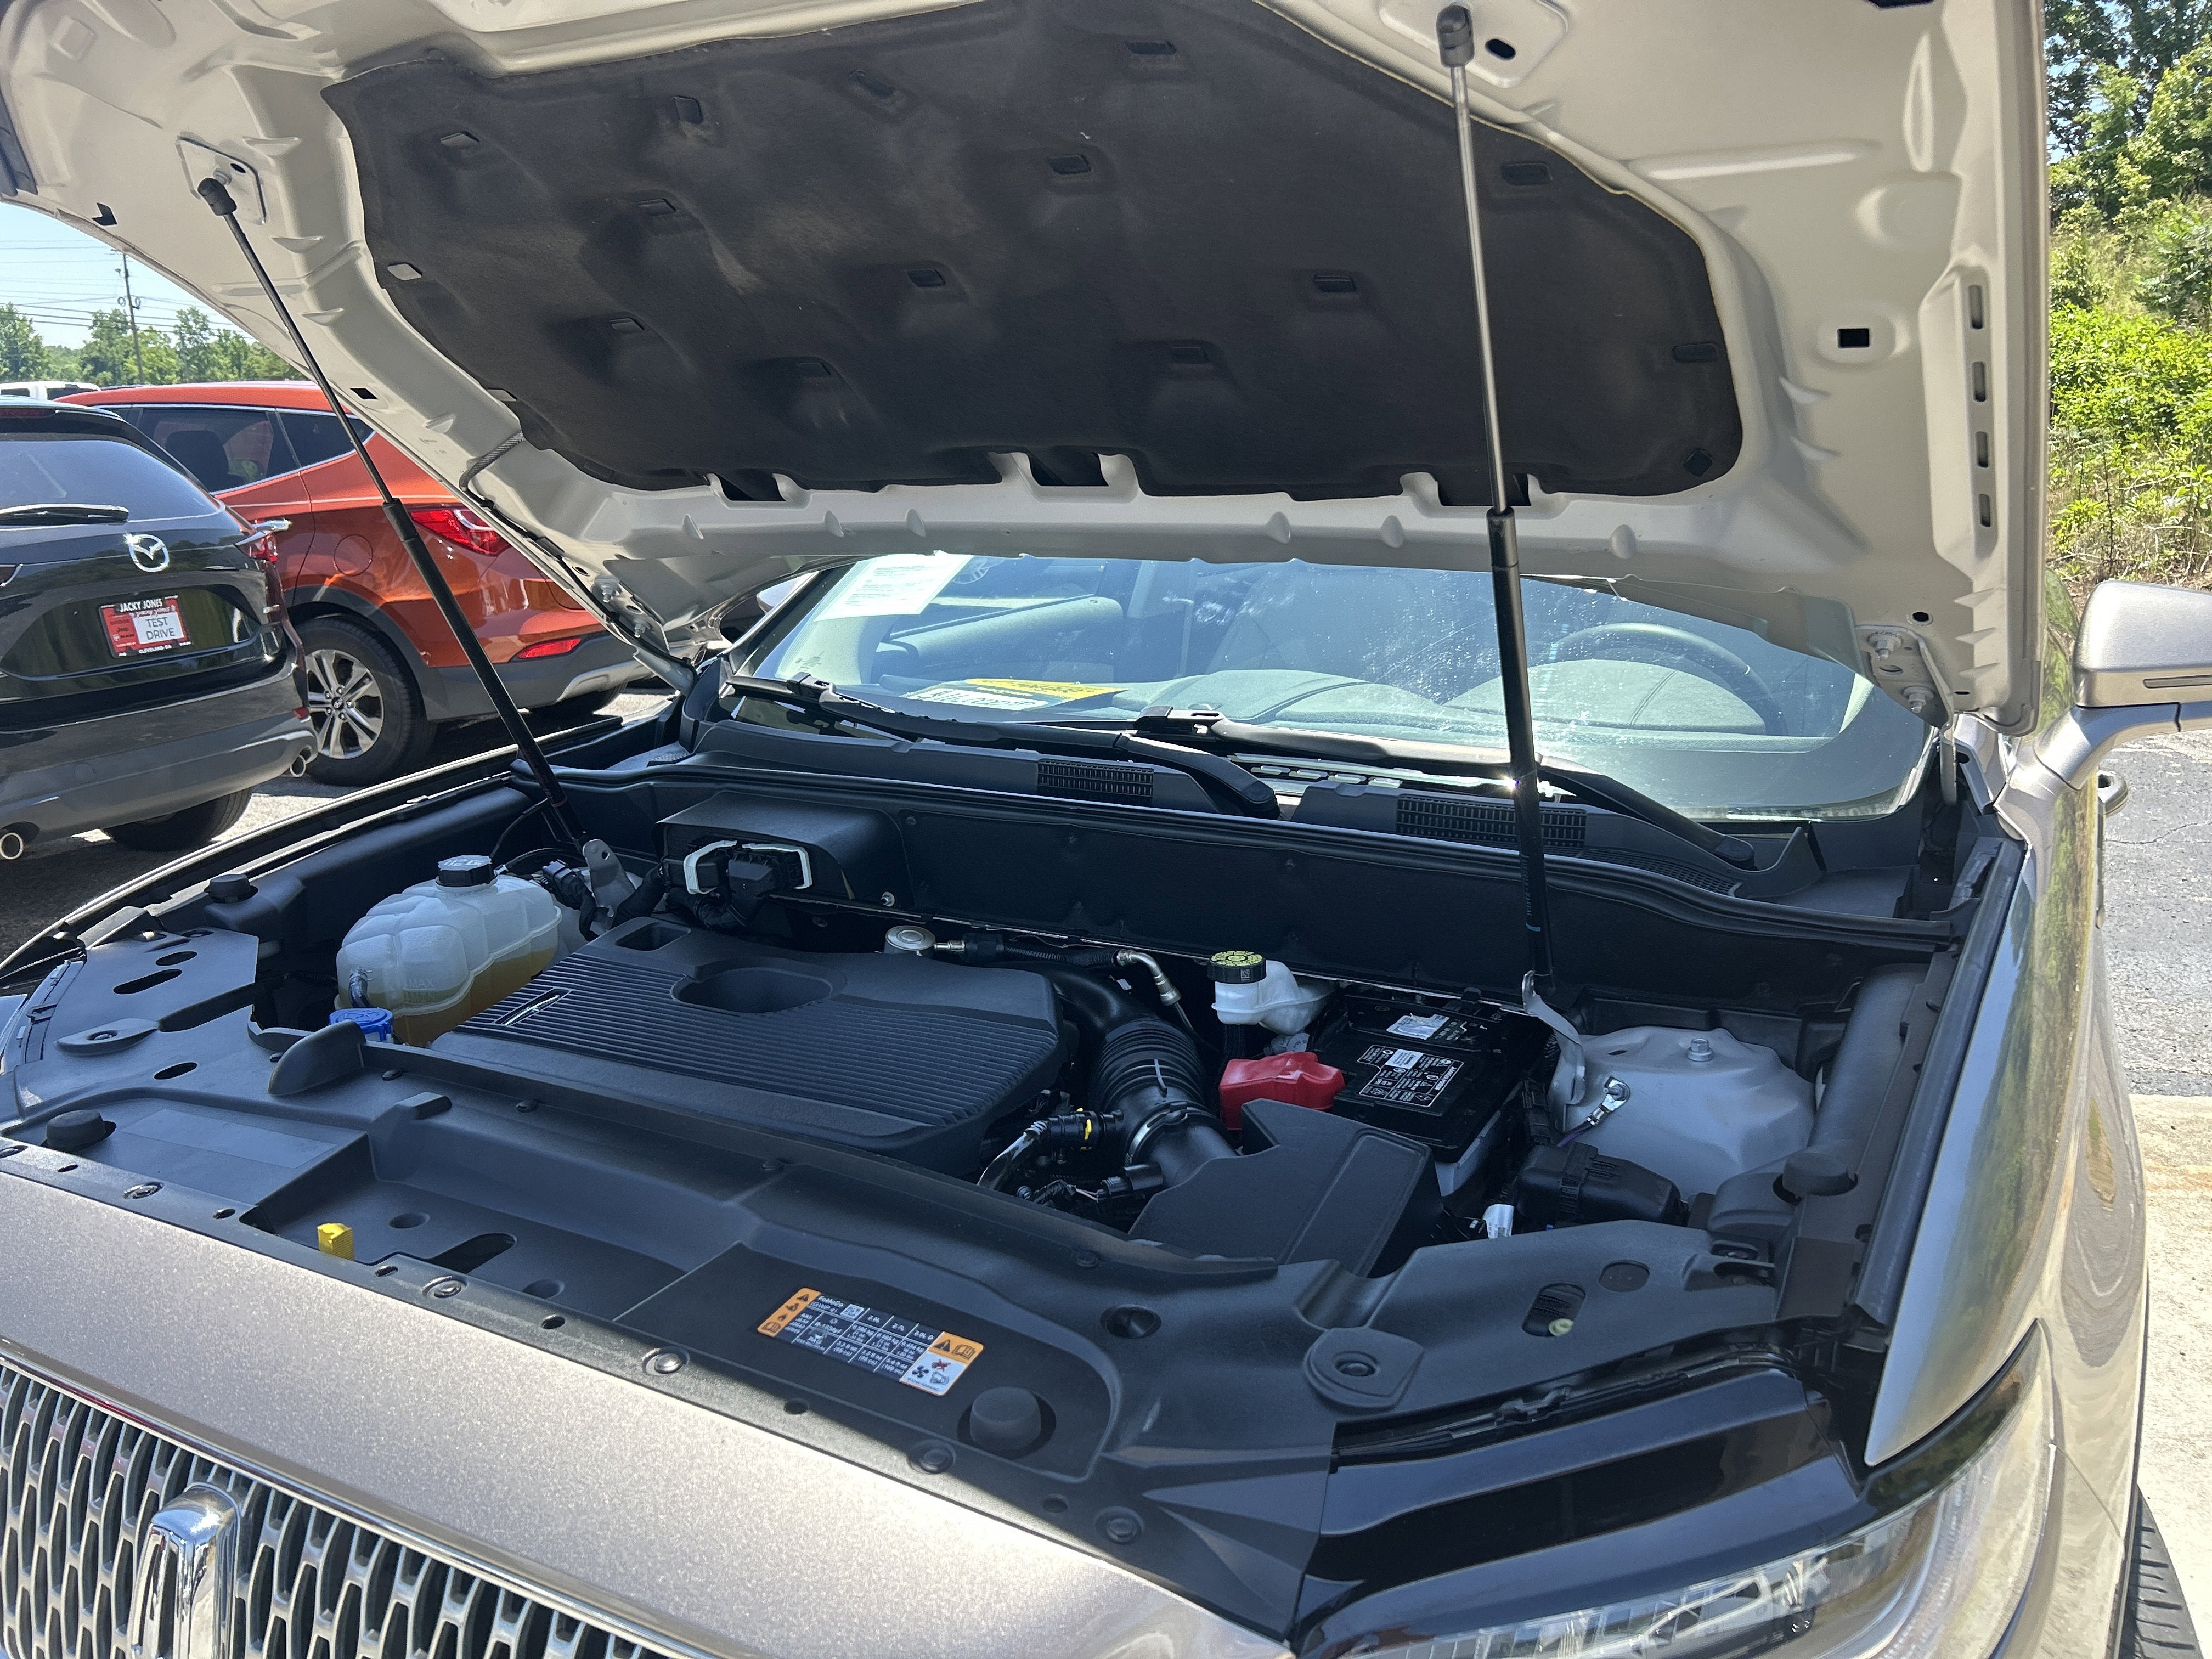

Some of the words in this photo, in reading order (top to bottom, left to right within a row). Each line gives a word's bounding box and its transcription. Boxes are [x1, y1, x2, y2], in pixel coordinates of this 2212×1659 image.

[120, 601, 141, 612] JACKY
[143, 599, 163, 609] JONES
[145, 617, 168, 628] TEST
[146, 628, 175, 640] DRIVE
[409, 978, 435, 988] MAX
